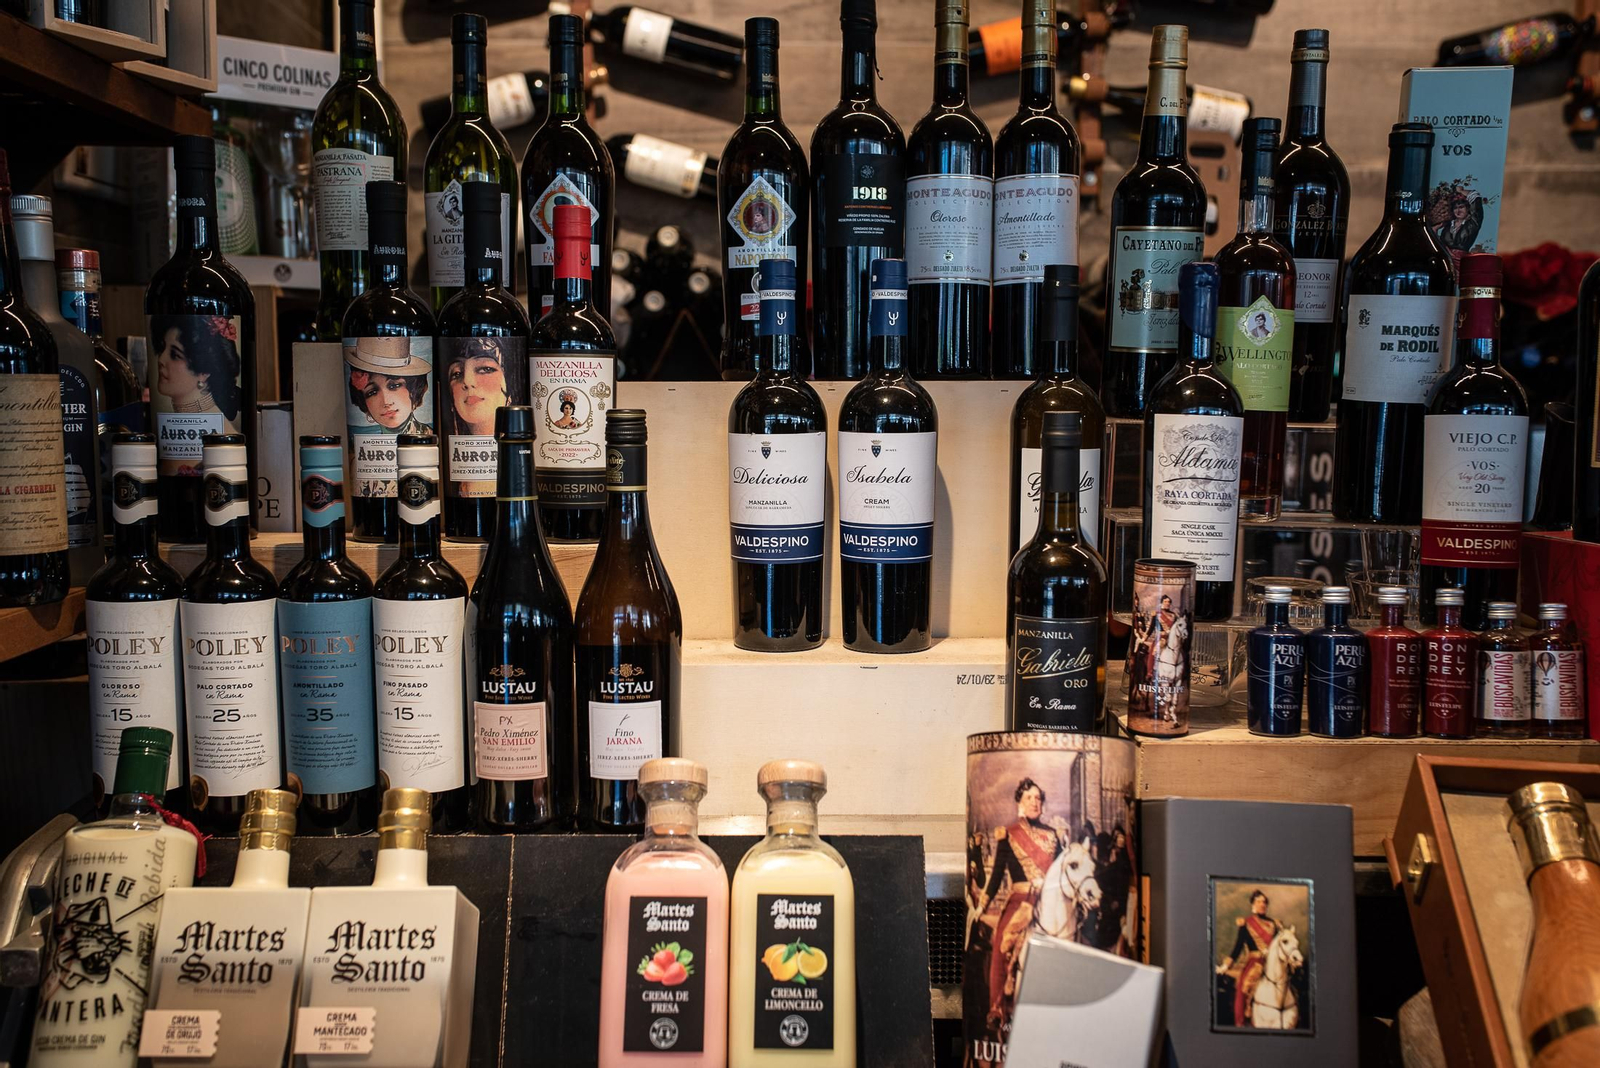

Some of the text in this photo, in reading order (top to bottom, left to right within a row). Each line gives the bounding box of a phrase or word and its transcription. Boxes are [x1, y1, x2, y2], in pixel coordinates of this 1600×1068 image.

[223, 56, 332, 90] CINCO COLINAS
[1443, 114, 1491, 126] CORTADO
[1442, 144, 1472, 156] VOS
[852, 186, 888, 201] 1918
[907, 187, 991, 201] MONTEAGUDO
[997, 211, 1056, 225] Amontillado
[433, 235, 443, 245] LA
[1122, 235, 1194, 252] CAYETANO DEL
[1381, 323, 1440, 338] MARQUÉS
[1380, 339, 1440, 353] DE RODIL
[535, 360, 602, 371] MANZANILLA
[540, 368, 598, 378] DELICIOSA
[63, 423, 83, 432] GIN
[1448, 432, 1518, 447] VIEJO C.P.
[1159, 445, 1238, 472] Aldama
[733, 465, 809, 485] Deliciosa
[846, 464, 913, 484] Isabela
[14, 484, 57, 495] CIGARRERA
[537, 482, 605, 493] VALDESPINO
[1474, 483, 1490, 494] 20
[1164, 489, 1232, 501] RAYA CORTADA
[734, 535, 809, 548] VALDESPINO
[843, 534, 918, 548] VALDESPINO
[1436, 536, 1518, 550] VALDESPINO
[1017, 628, 1074, 640] MANZANILLA
[88, 635, 166, 656] POLEY
[185, 635, 267, 656] POLEY
[281, 635, 360, 656] POLEY
[374, 635, 448, 655] POLEY
[1428, 641, 1468, 653] RON
[309, 662, 358, 671] TORO ALBALÁ
[396, 662, 444, 671] TORO ALBALÁ
[1016, 646, 1095, 675] Gabriela
[1272, 655, 1302, 669] AZUL
[1428, 655, 1466, 665] DEL
[134, 663, 163, 671] ALBALÁ
[215, 663, 265, 672] TORO ALBALÁ
[1428, 666, 1467, 676] REY
[101, 682, 140, 690] OLOROSO
[196, 682, 253, 690] PALO CORTADO
[383, 680, 428, 689] FINO PASADO
[957, 674, 995, 685] 29/01/24
[1063, 679, 1088, 689] ORO
[1493, 652, 1514, 708] BUSCAVIDAS
[1558, 652, 1578, 709] BUSCAVIDAS
[482, 680, 536, 694] LUSTAU
[600, 680, 654, 694] LUSTAU
[1138, 683, 1157, 693] LUIS
[1028, 695, 1077, 711] En Rama
[110, 708, 133, 722] 15
[212, 708, 241, 722] 25
[305, 707, 334, 722] 35
[393, 706, 414, 721] 15
[499, 715, 513, 725] PX
[480, 727, 539, 738] Pedro Ximénez
[614, 727, 634, 737] Fino
[482, 736, 536, 746] SAN EMILIO
[606, 736, 643, 746] JARANA
[116, 875, 136, 898] DE
[642, 900, 695, 919] Martes
[769, 898, 822, 917] Martes
[645, 916, 690, 933] Santo
[773, 913, 818, 930] Santo
[171, 919, 287, 955] Martes
[324, 919, 438, 955] Martes
[177, 952, 275, 985] Santo
[330, 952, 427, 985] Santo
[641, 990, 689, 1003] CREMA DE
[770, 986, 818, 999] CREMA DE
[650, 1002, 680, 1014] FRESA
[764, 999, 824, 1012] LIMONCELLO
[171, 1015, 201, 1026] CREMA
[326, 1012, 357, 1023] CREMA
[165, 1029, 176, 1040] DE
[313, 1026, 368, 1037] MANTECADO
